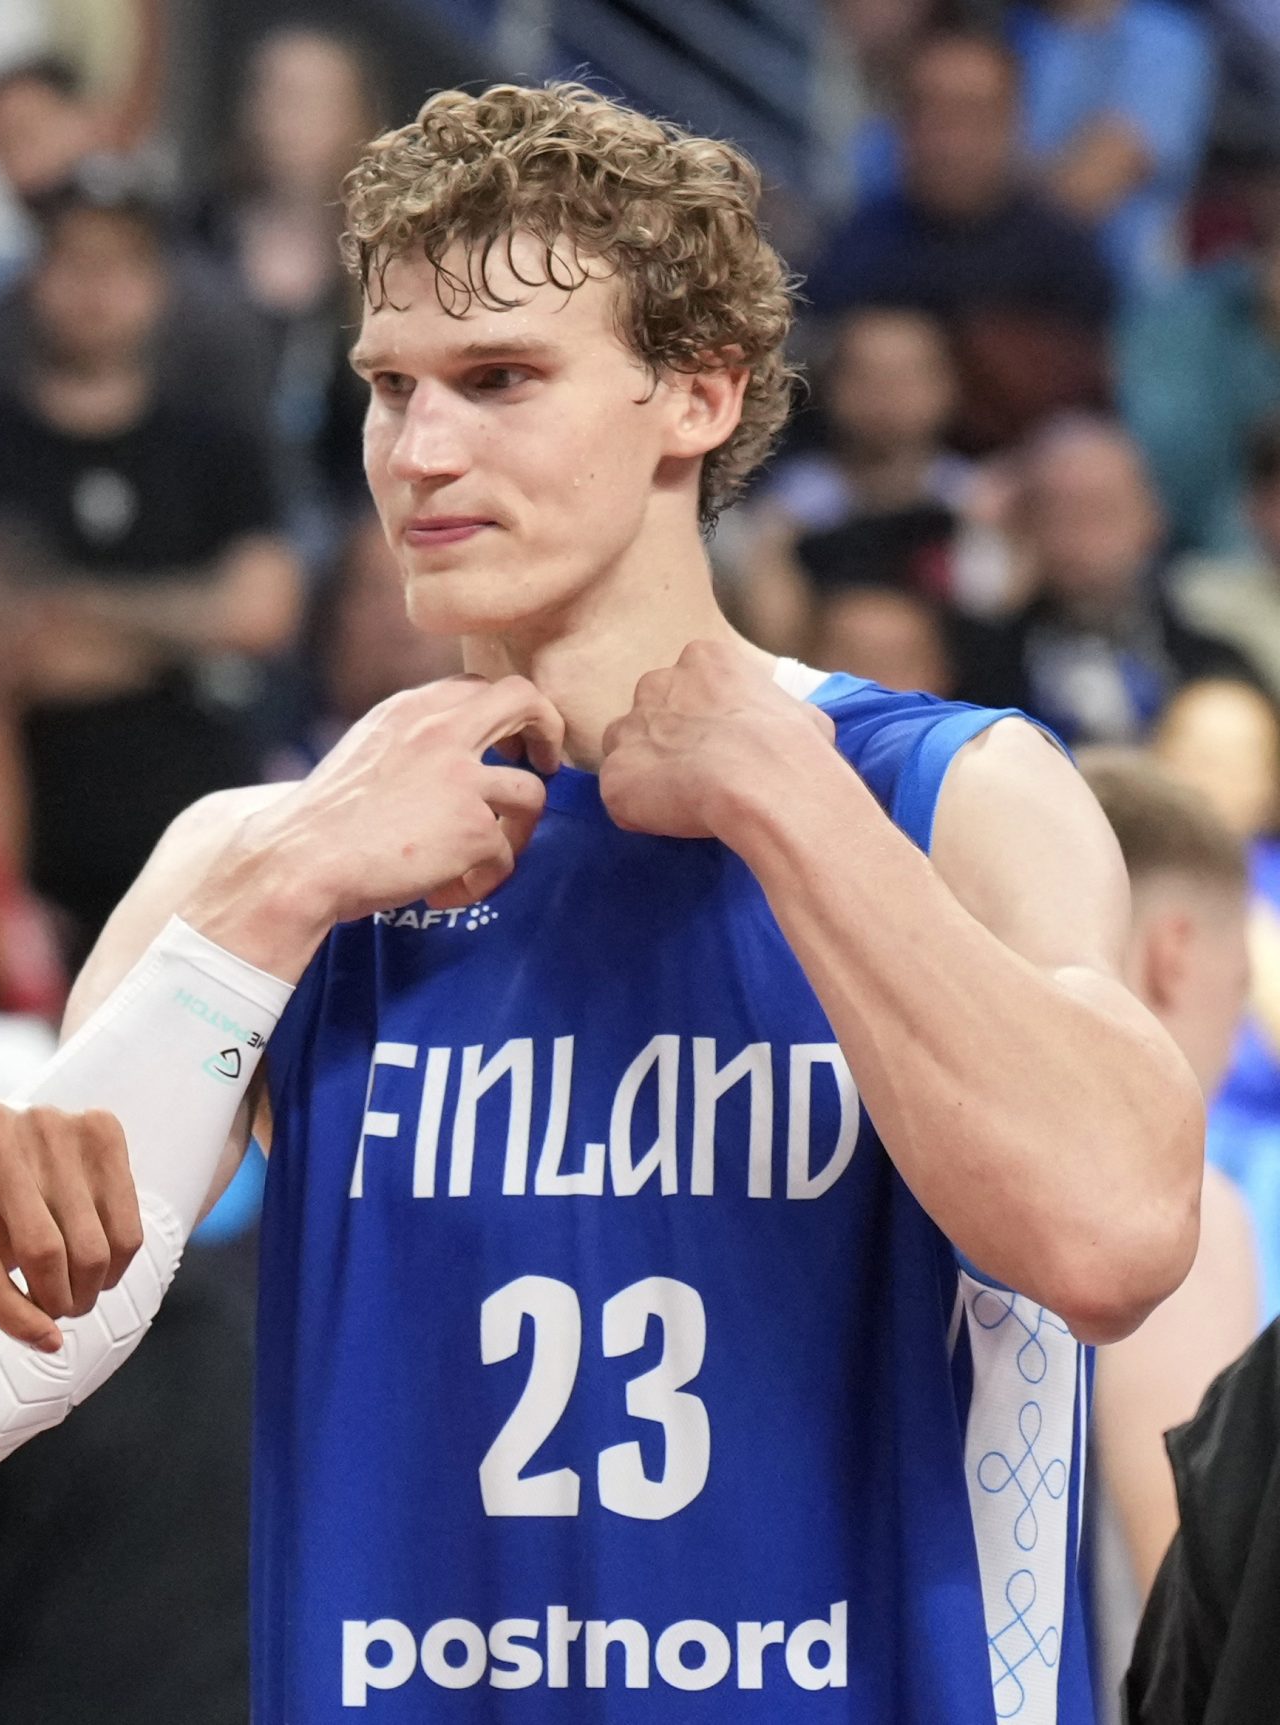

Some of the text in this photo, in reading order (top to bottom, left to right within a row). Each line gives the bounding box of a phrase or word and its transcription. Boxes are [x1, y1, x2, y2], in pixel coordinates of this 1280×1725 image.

[373, 906, 467, 929] RAFT
[478, 1274, 711, 1521] 23
[342, 1600, 848, 1707] postnord
